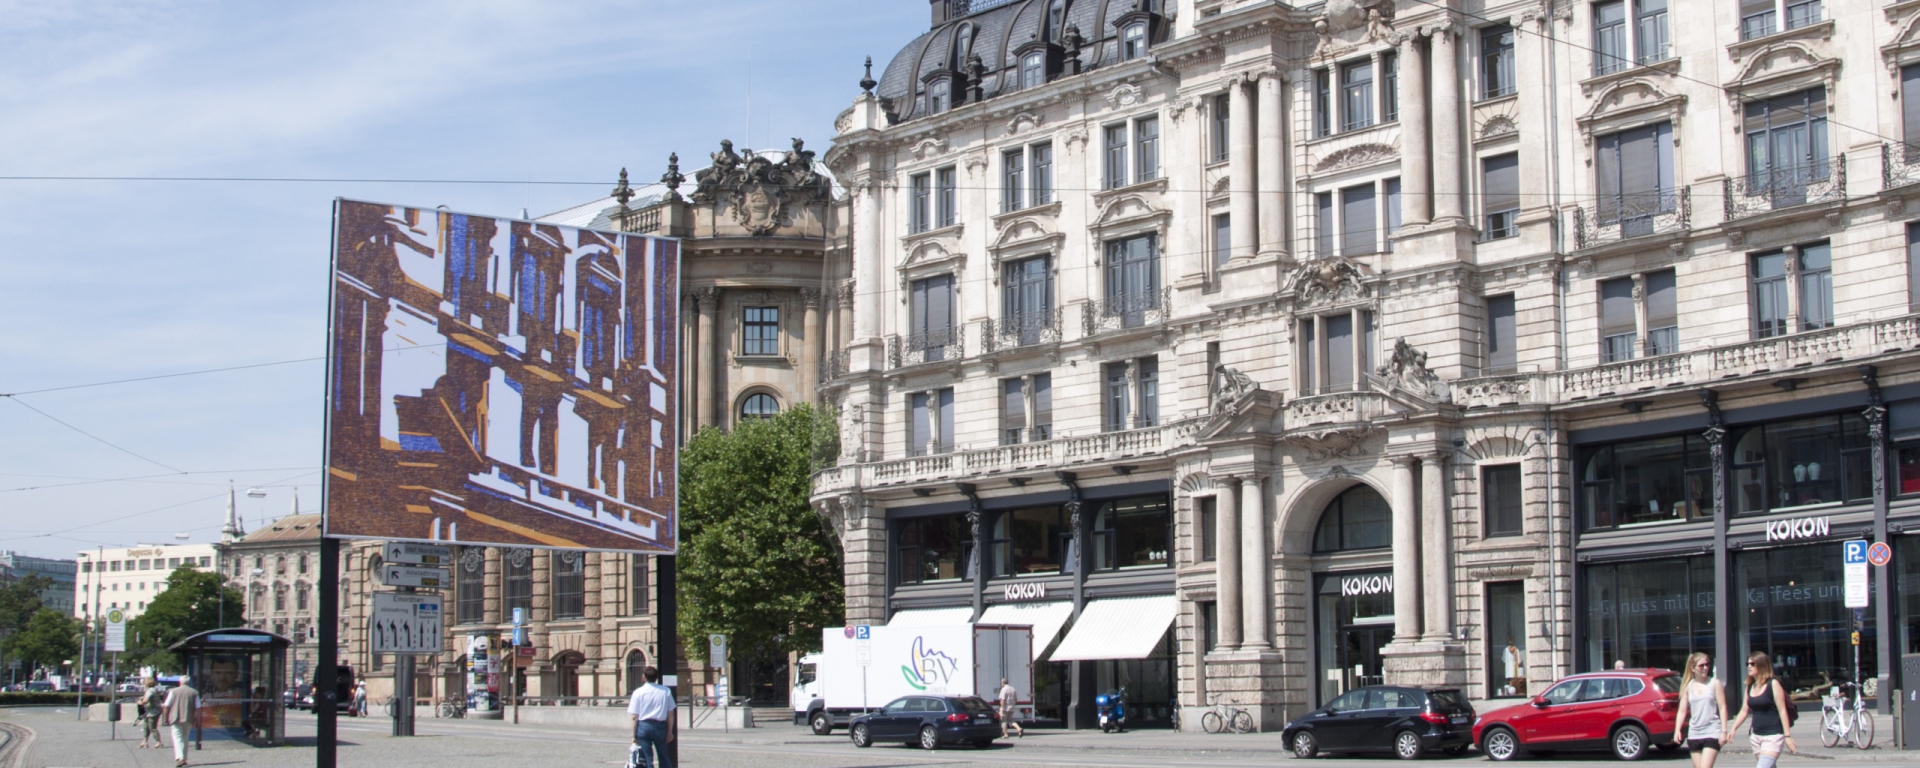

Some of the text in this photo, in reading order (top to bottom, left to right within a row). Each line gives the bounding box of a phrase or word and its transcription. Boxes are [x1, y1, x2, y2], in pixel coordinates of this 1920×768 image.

[1766, 516, 1829, 542] KOKON
[1847, 543, 1861, 562] P
[405, 569, 440, 578] Altstadtring
[1005, 582, 1045, 600] KOKON
[1341, 575, 1393, 597] KOKON
[393, 595, 424, 603] Einordnen
[1664, 594, 1689, 610] mit
[1818, 585, 1846, 599] un
[857, 626, 867, 638] P
[922, 658, 957, 685] BV
